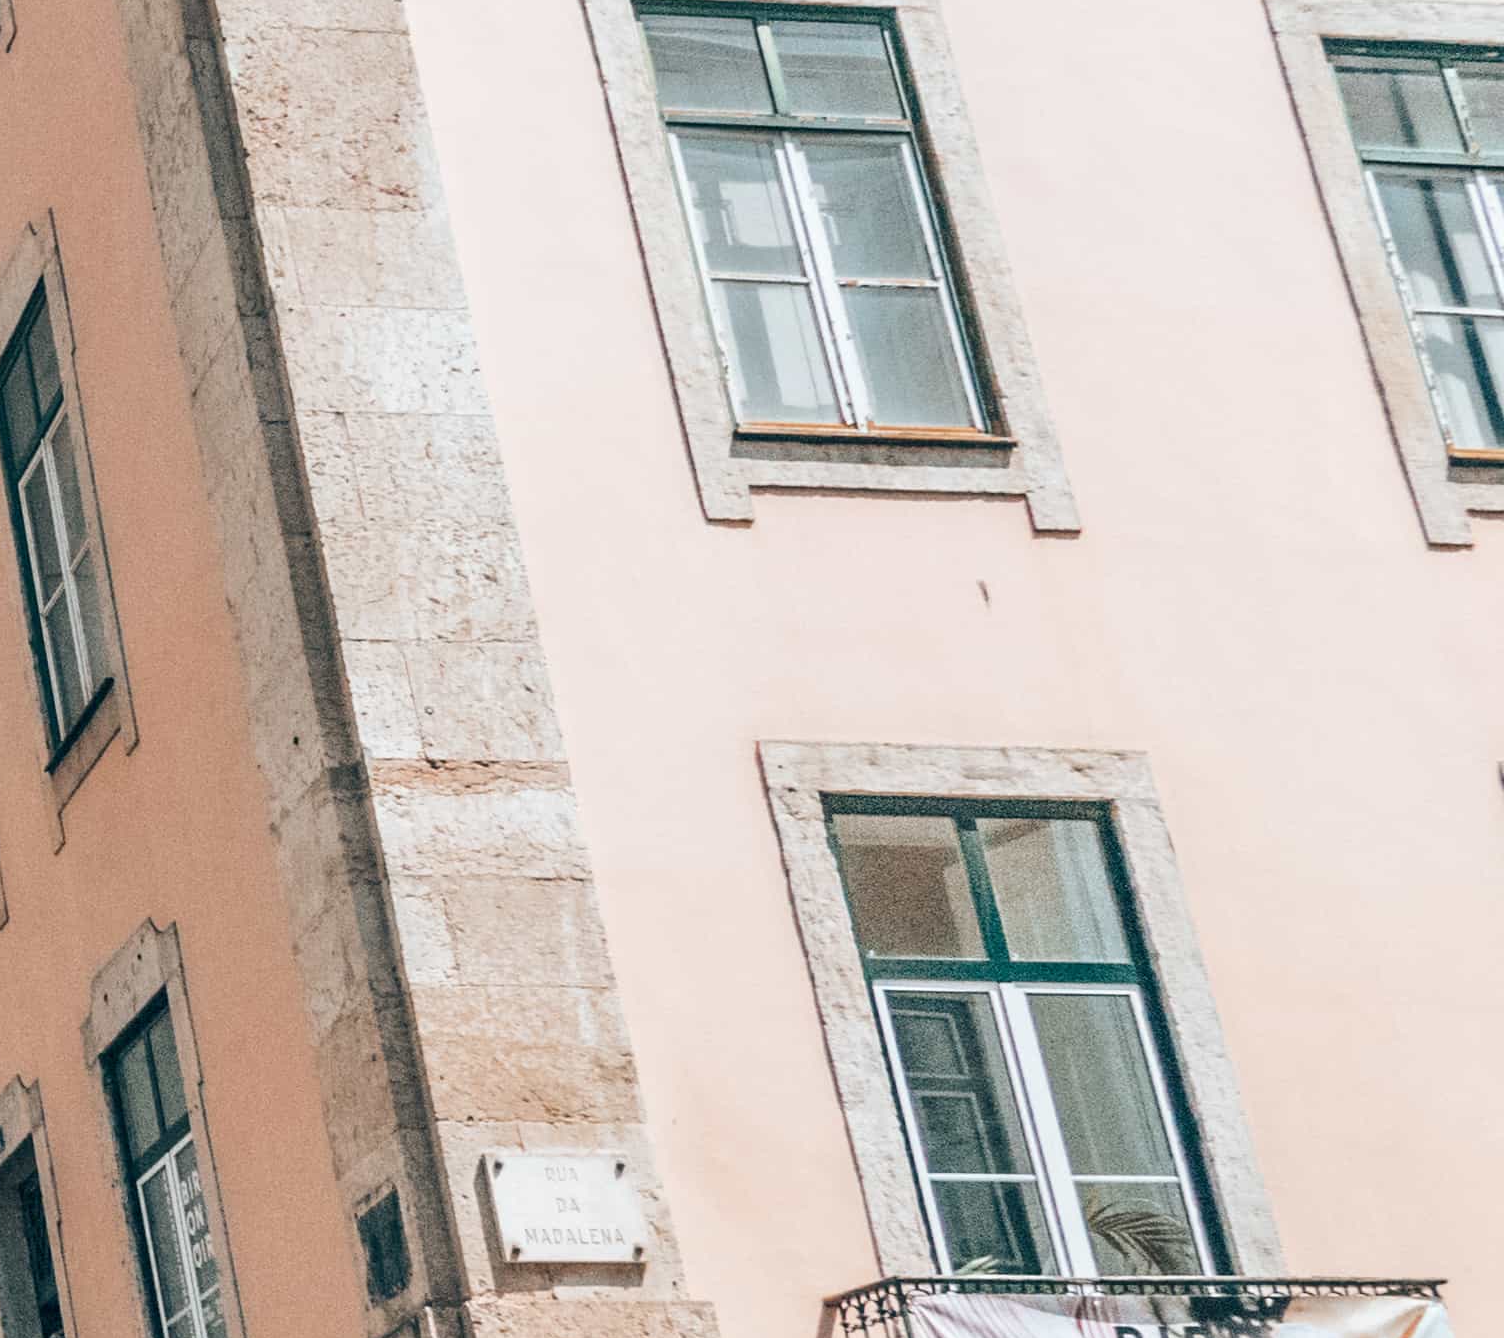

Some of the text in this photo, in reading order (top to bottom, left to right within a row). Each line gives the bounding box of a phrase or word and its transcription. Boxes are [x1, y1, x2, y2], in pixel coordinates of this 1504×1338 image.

[544, 1166, 579, 1182] RUA
[555, 1197, 581, 1213] DA
[524, 1228, 626, 1246] MADALENA
